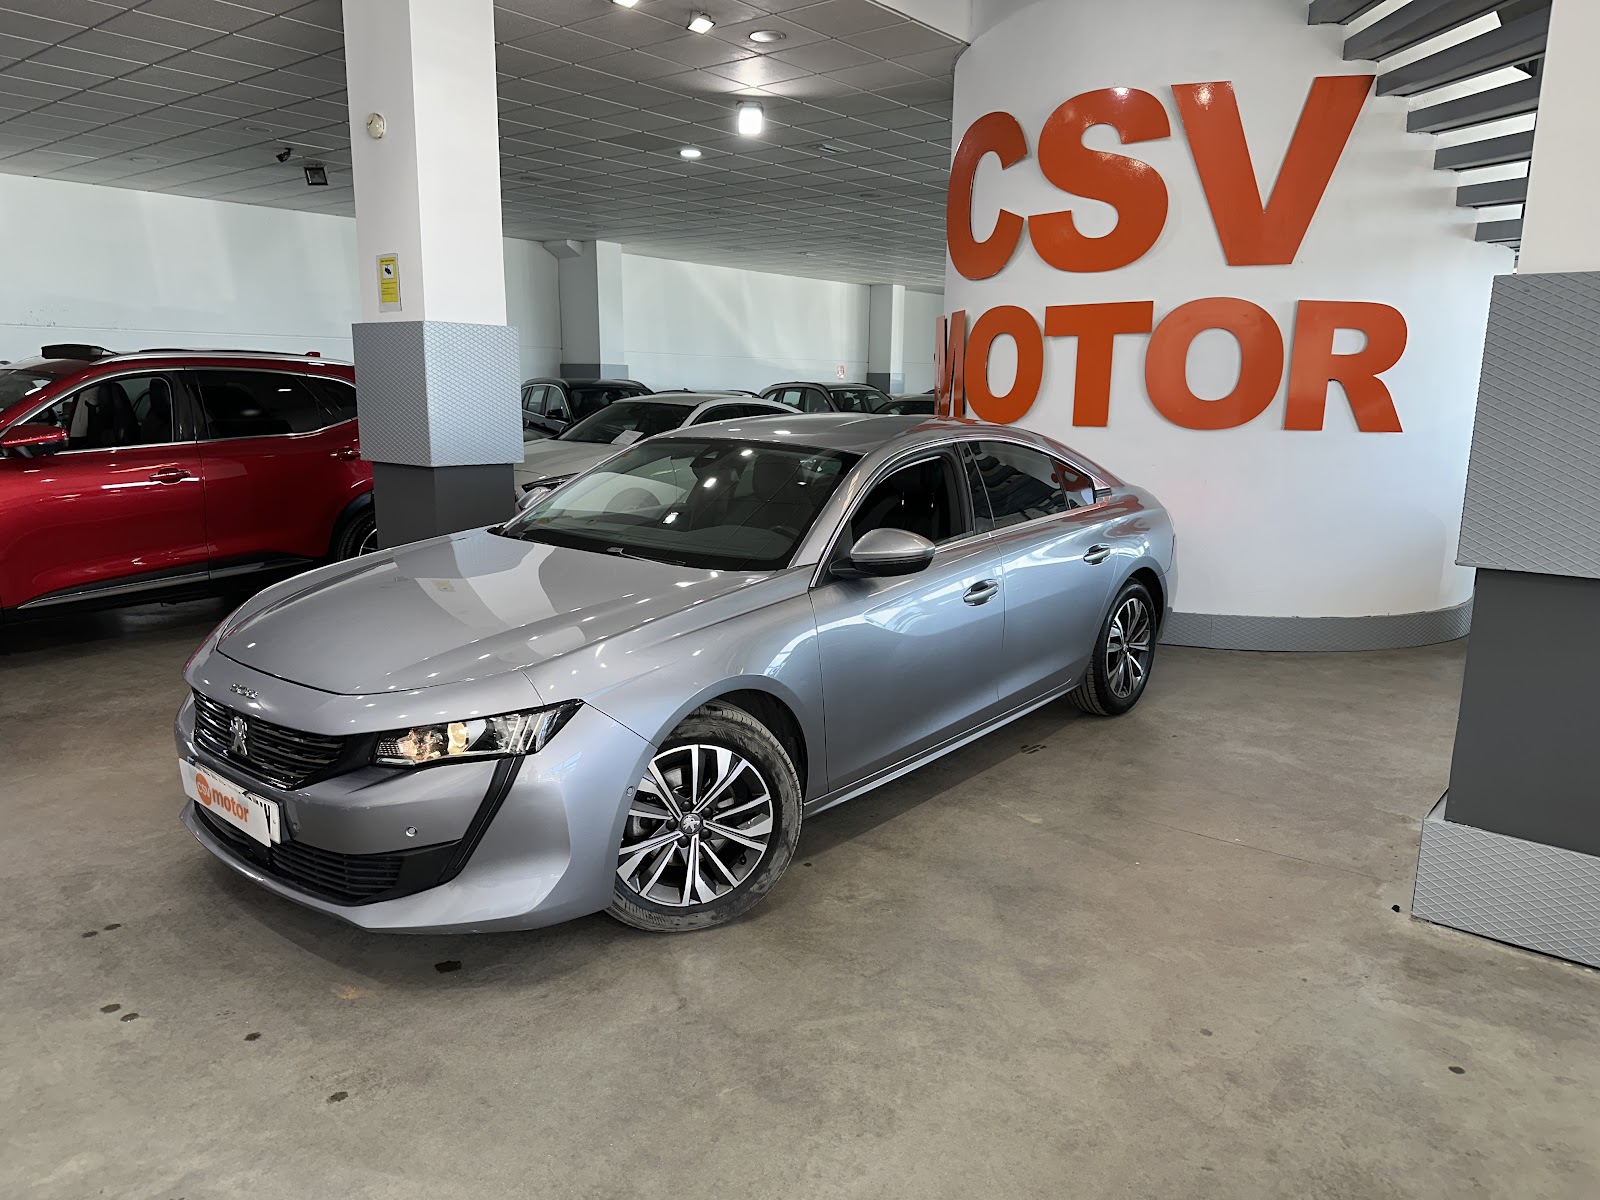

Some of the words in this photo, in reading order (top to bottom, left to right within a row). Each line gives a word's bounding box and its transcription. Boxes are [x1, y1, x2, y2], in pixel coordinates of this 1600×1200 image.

[946, 75, 1376, 281] CSV
[935, 296, 1408, 432] MOTOR
[212, 787, 249, 822] motor
